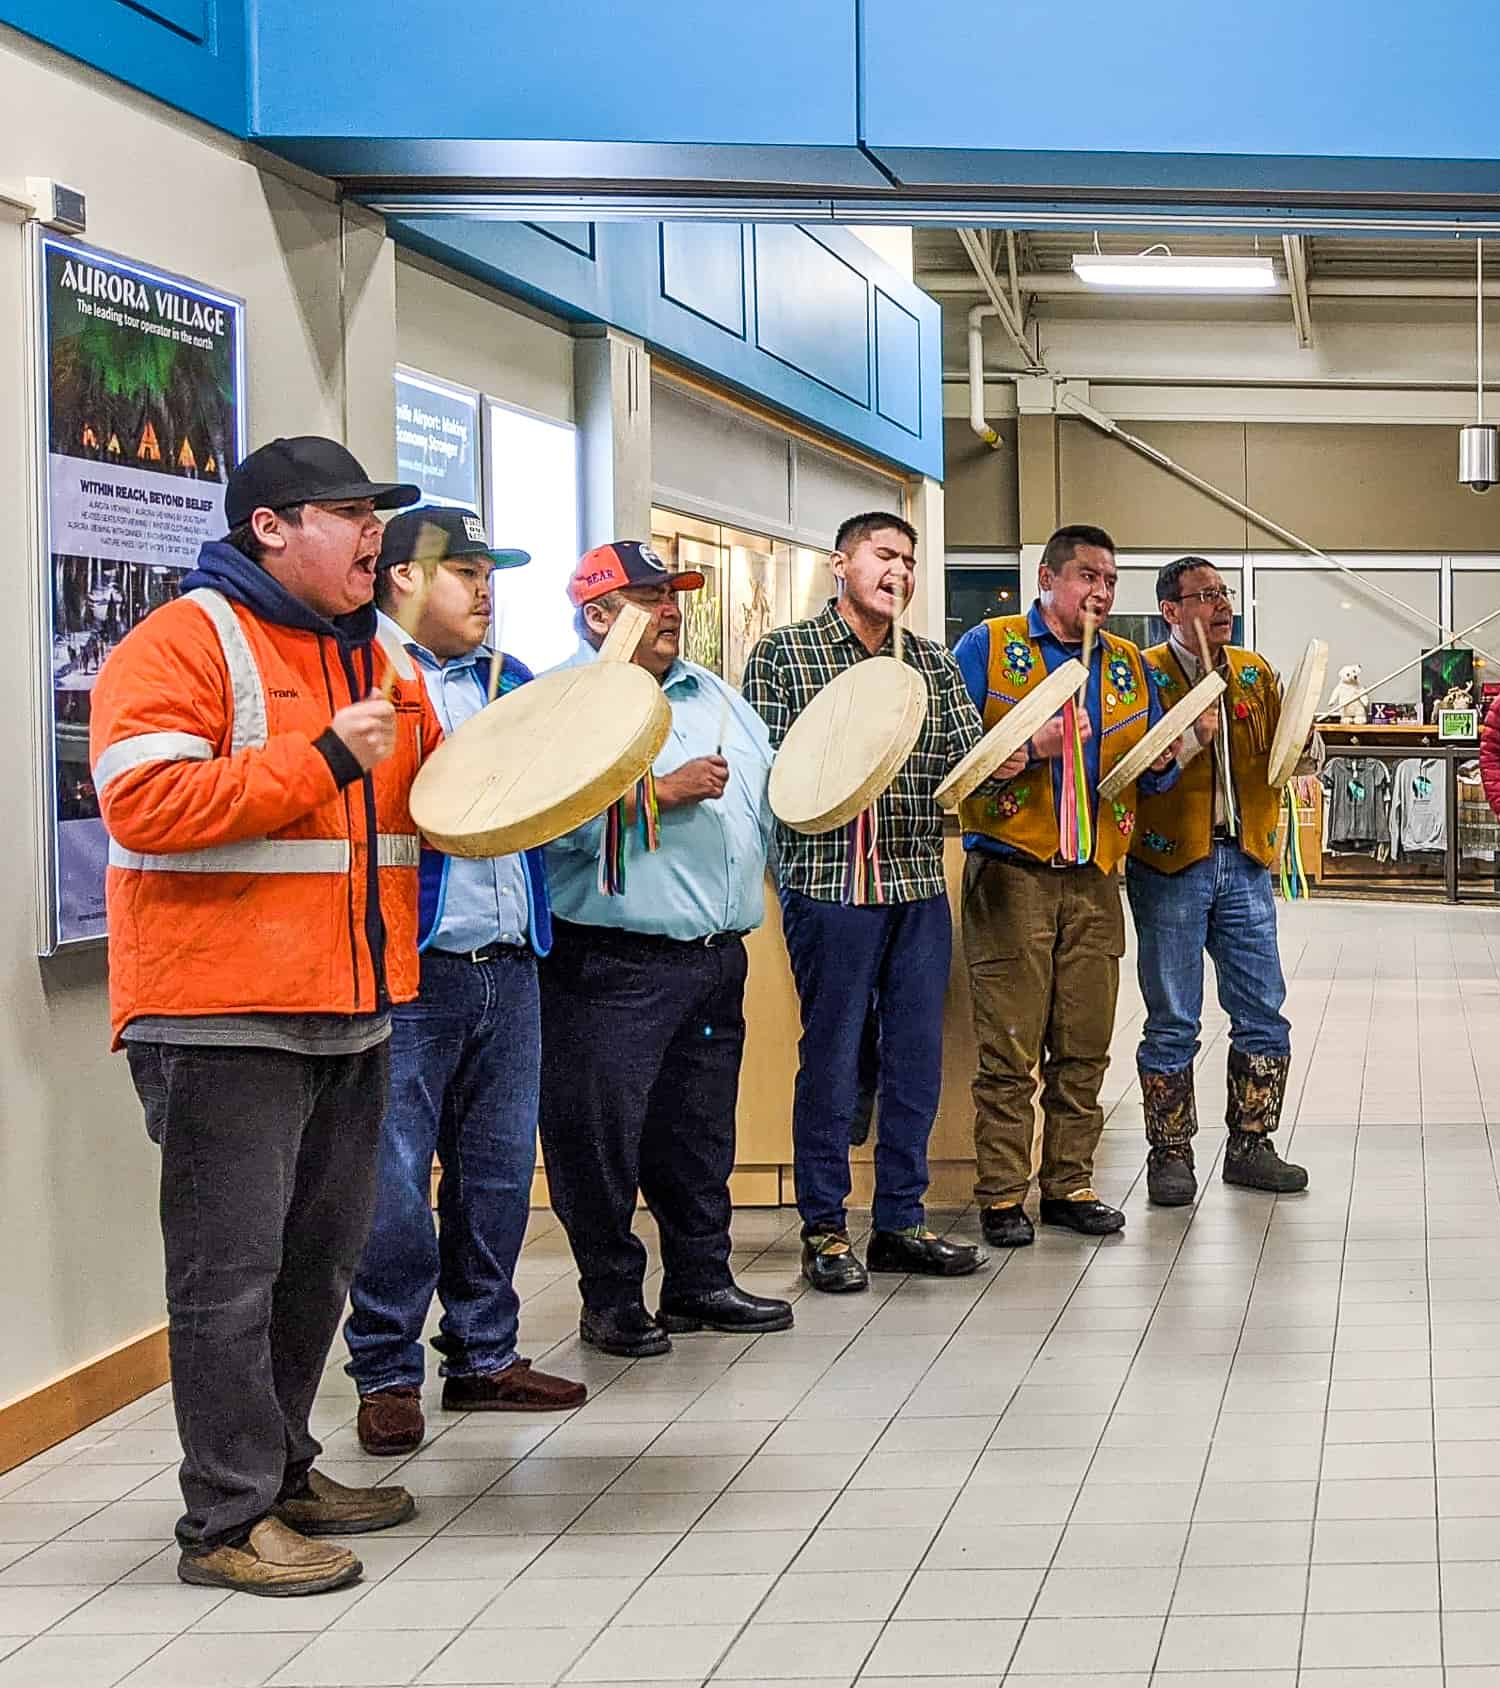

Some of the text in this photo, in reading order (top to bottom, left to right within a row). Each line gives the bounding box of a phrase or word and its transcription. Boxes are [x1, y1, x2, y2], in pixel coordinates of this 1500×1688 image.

[60, 261, 225, 336] AURORA VILLAGE
[77, 298, 214, 351] The leading tour operator in the north
[80, 479, 114, 498] WITHIN
[115, 486, 149, 504] REACH,
[149, 491, 185, 508] BEYOND
[185, 497, 214, 512] BELIEF
[268, 688, 299, 698] Frank
